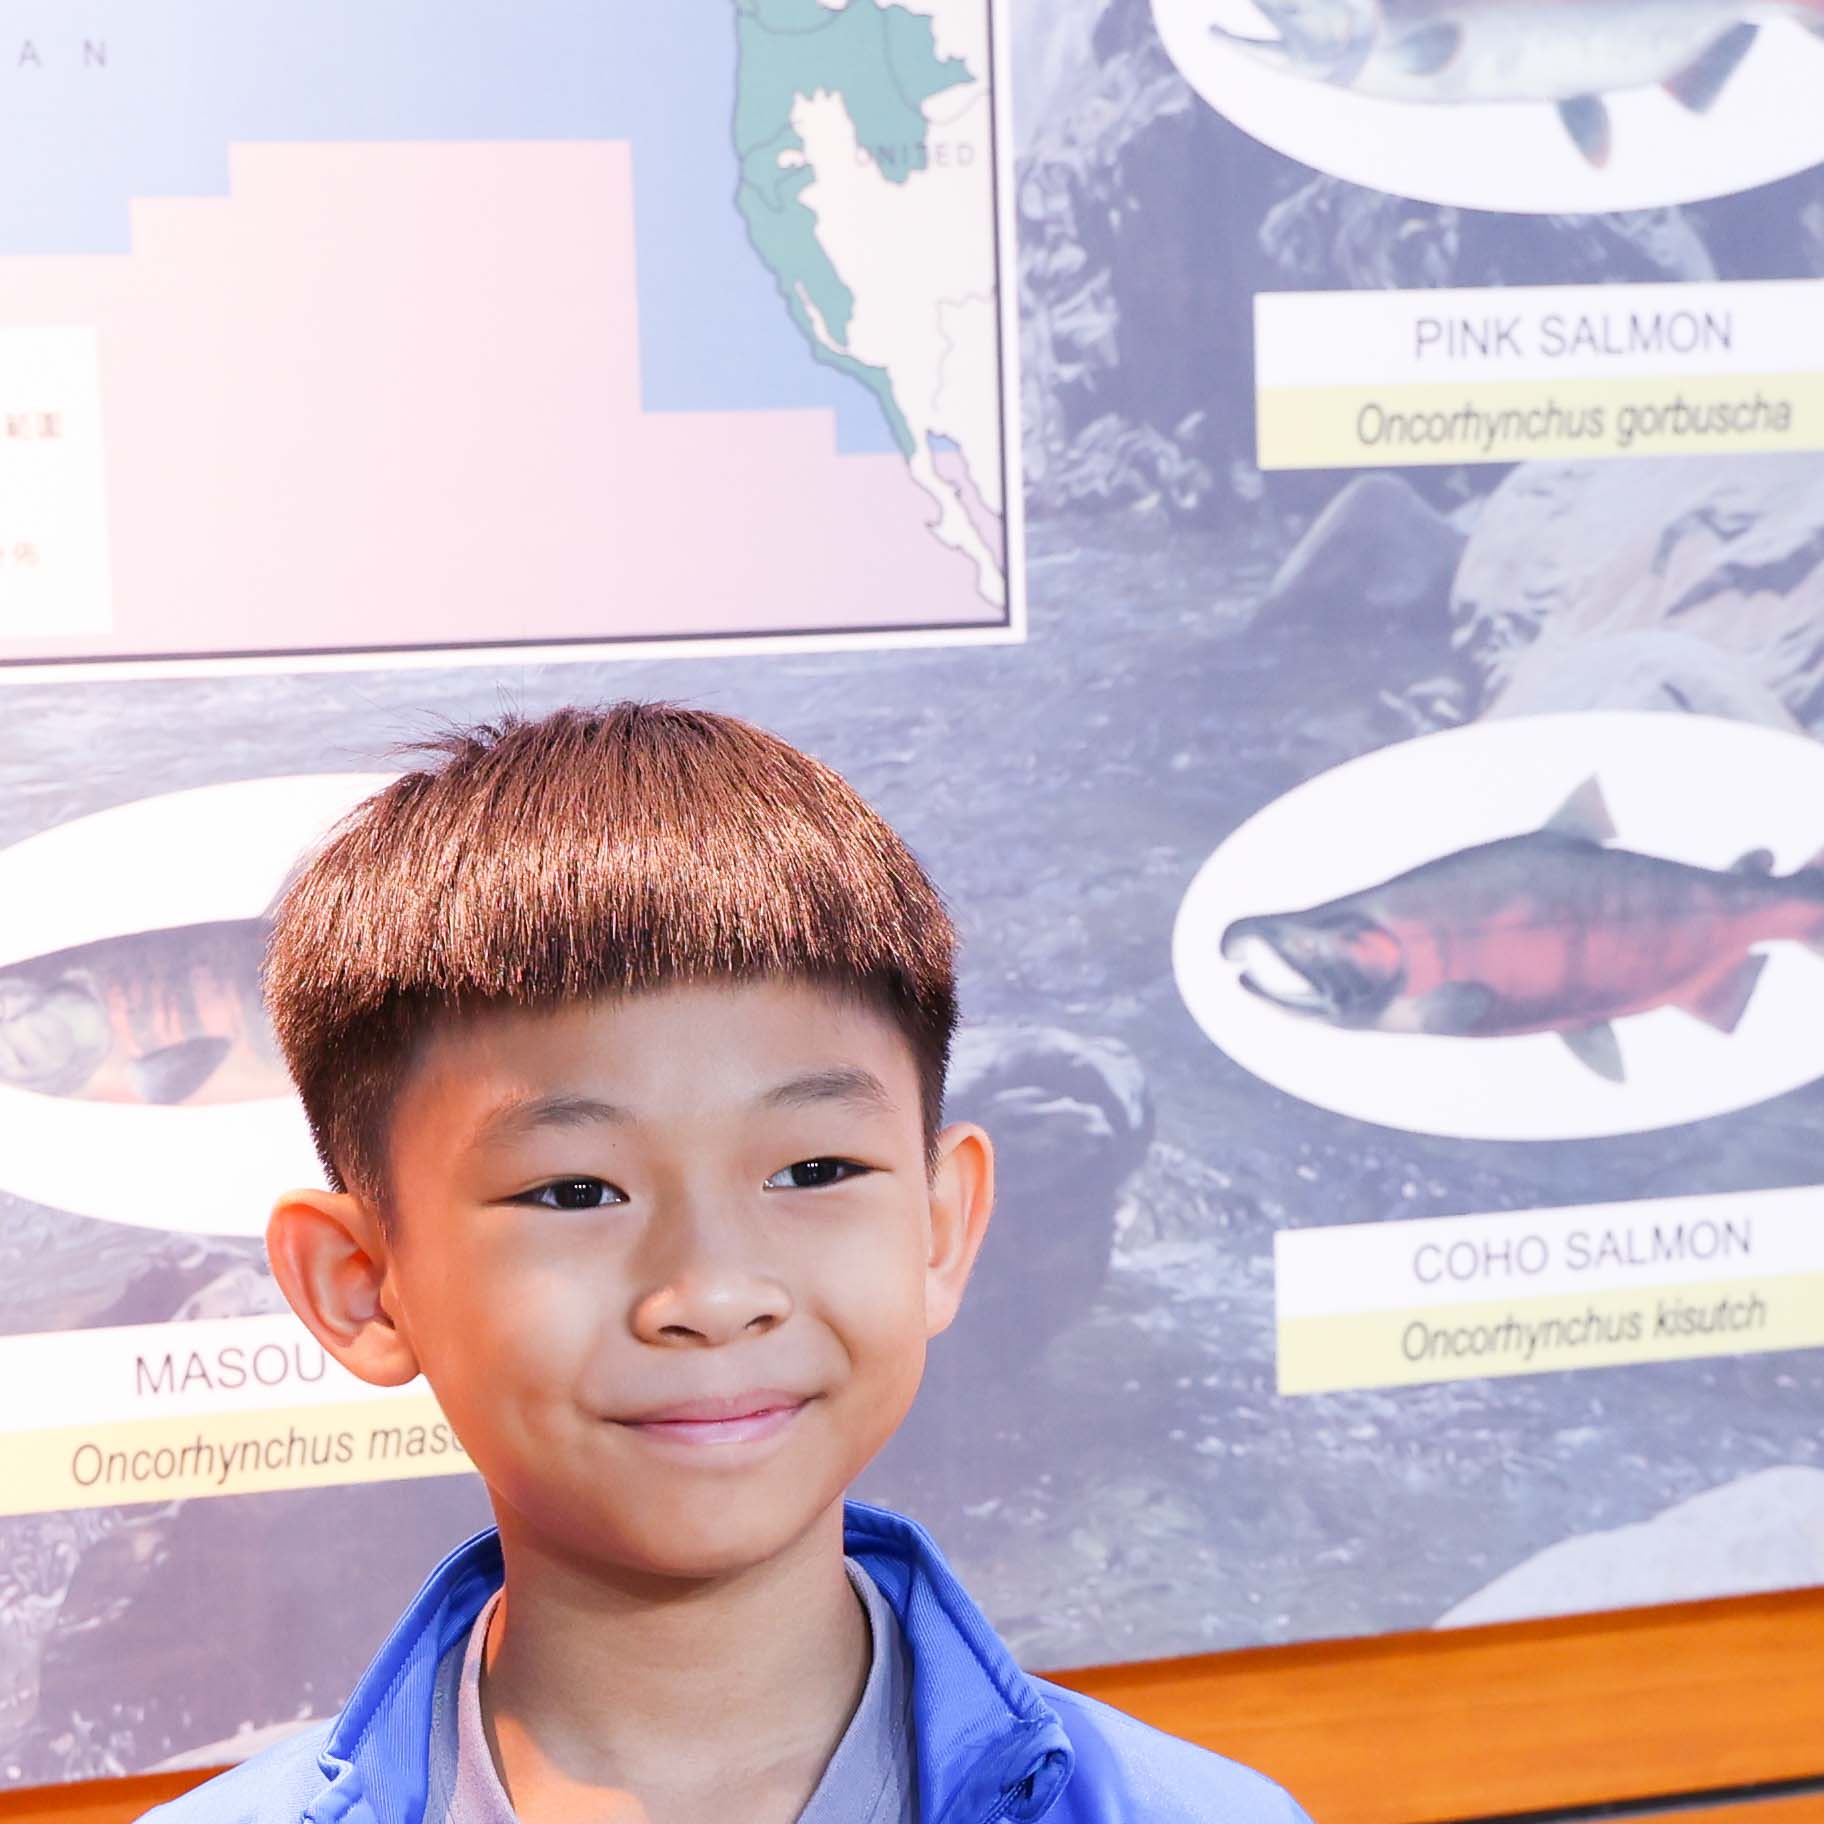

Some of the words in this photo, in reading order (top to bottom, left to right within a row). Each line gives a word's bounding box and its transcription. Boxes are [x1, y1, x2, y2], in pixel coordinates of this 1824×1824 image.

[1415, 316, 1523, 359] PINK
[1540, 310, 1733, 356] SALMON
[1357, 396, 1604, 452] Oncorhynchus
[1617, 390, 1793, 447] gorbuscha
[1414, 1234, 1550, 1284] COHO
[1566, 1218, 1752, 1271] SALMON
[1402, 1308, 1644, 1363] Oncorhynchus
[1653, 1293, 1767, 1338] kisutch
[136, 1344, 326, 1396] MASOU
[72, 1426, 355, 1486] Oncorhynchus
